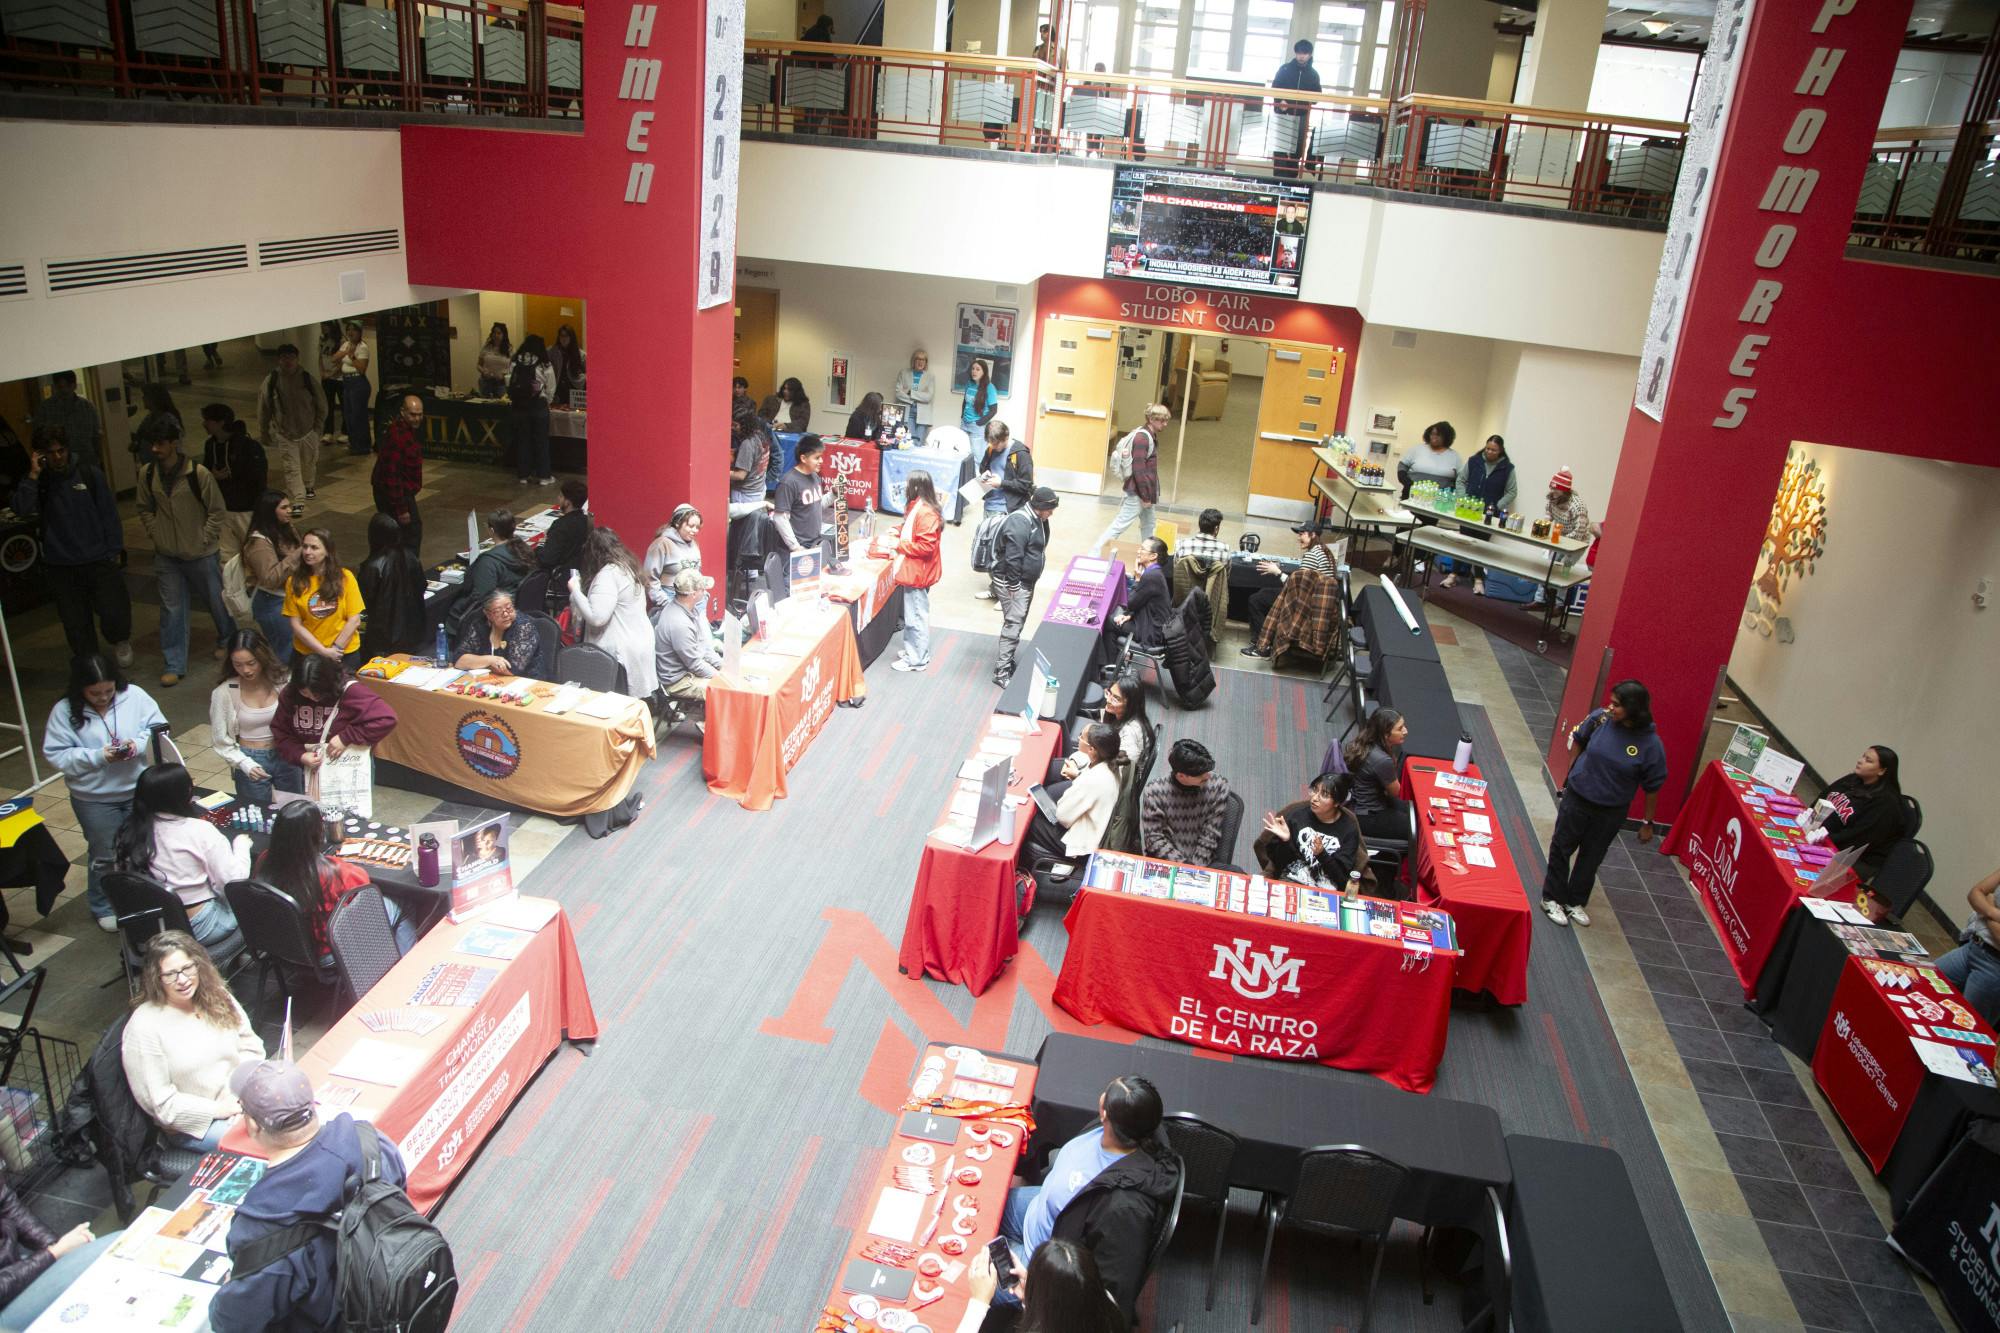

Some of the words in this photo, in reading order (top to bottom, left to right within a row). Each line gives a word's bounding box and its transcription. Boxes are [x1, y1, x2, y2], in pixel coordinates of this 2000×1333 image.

[709, 74, 727, 295] 2029
[1167, 198, 1246, 212] CHAMPIONS
[1149, 260, 1178, 271] INDIANA
[1178, 263, 1213, 275] HOOSIERS
[1223, 268, 1245, 278] AIDEN
[1245, 270, 1270, 280] FISHER
[1120, 303, 1208, 326] STUDENT
[1215, 313, 1276, 333] QUAD
[1145, 285, 1198, 305] LOBO
[1206, 292, 1251, 311] LAIR
[1728, 918, 1749, 956] Center
[445, 1012, 488, 1067] CHANGE
[1170, 1014, 1204, 1039] DE
[1210, 1024, 1242, 1049] LA
[1249, 1034, 1319, 1059] RAZA
[1178, 996, 1209, 1018] EL
[1215, 1006, 1319, 1039] CENTRO
[438, 1061, 459, 1089] THE
[459, 1017, 497, 1064] WORLD
[406, 1114, 435, 1152] BEGIN
[435, 1084, 459, 1115] YOUR
[459, 1005, 525, 1087] UNDERGRADUATE
[1847, 1041, 1877, 1081] ADVOCACY
[1875, 1078, 1898, 1112] CENTER
[414, 1100, 460, 1159] RESEARCH
[461, 1055, 497, 1102] JOURNEY
[1948, 1220, 2000, 1294] STUDENT
[1950, 1244, 1958, 1261] &
